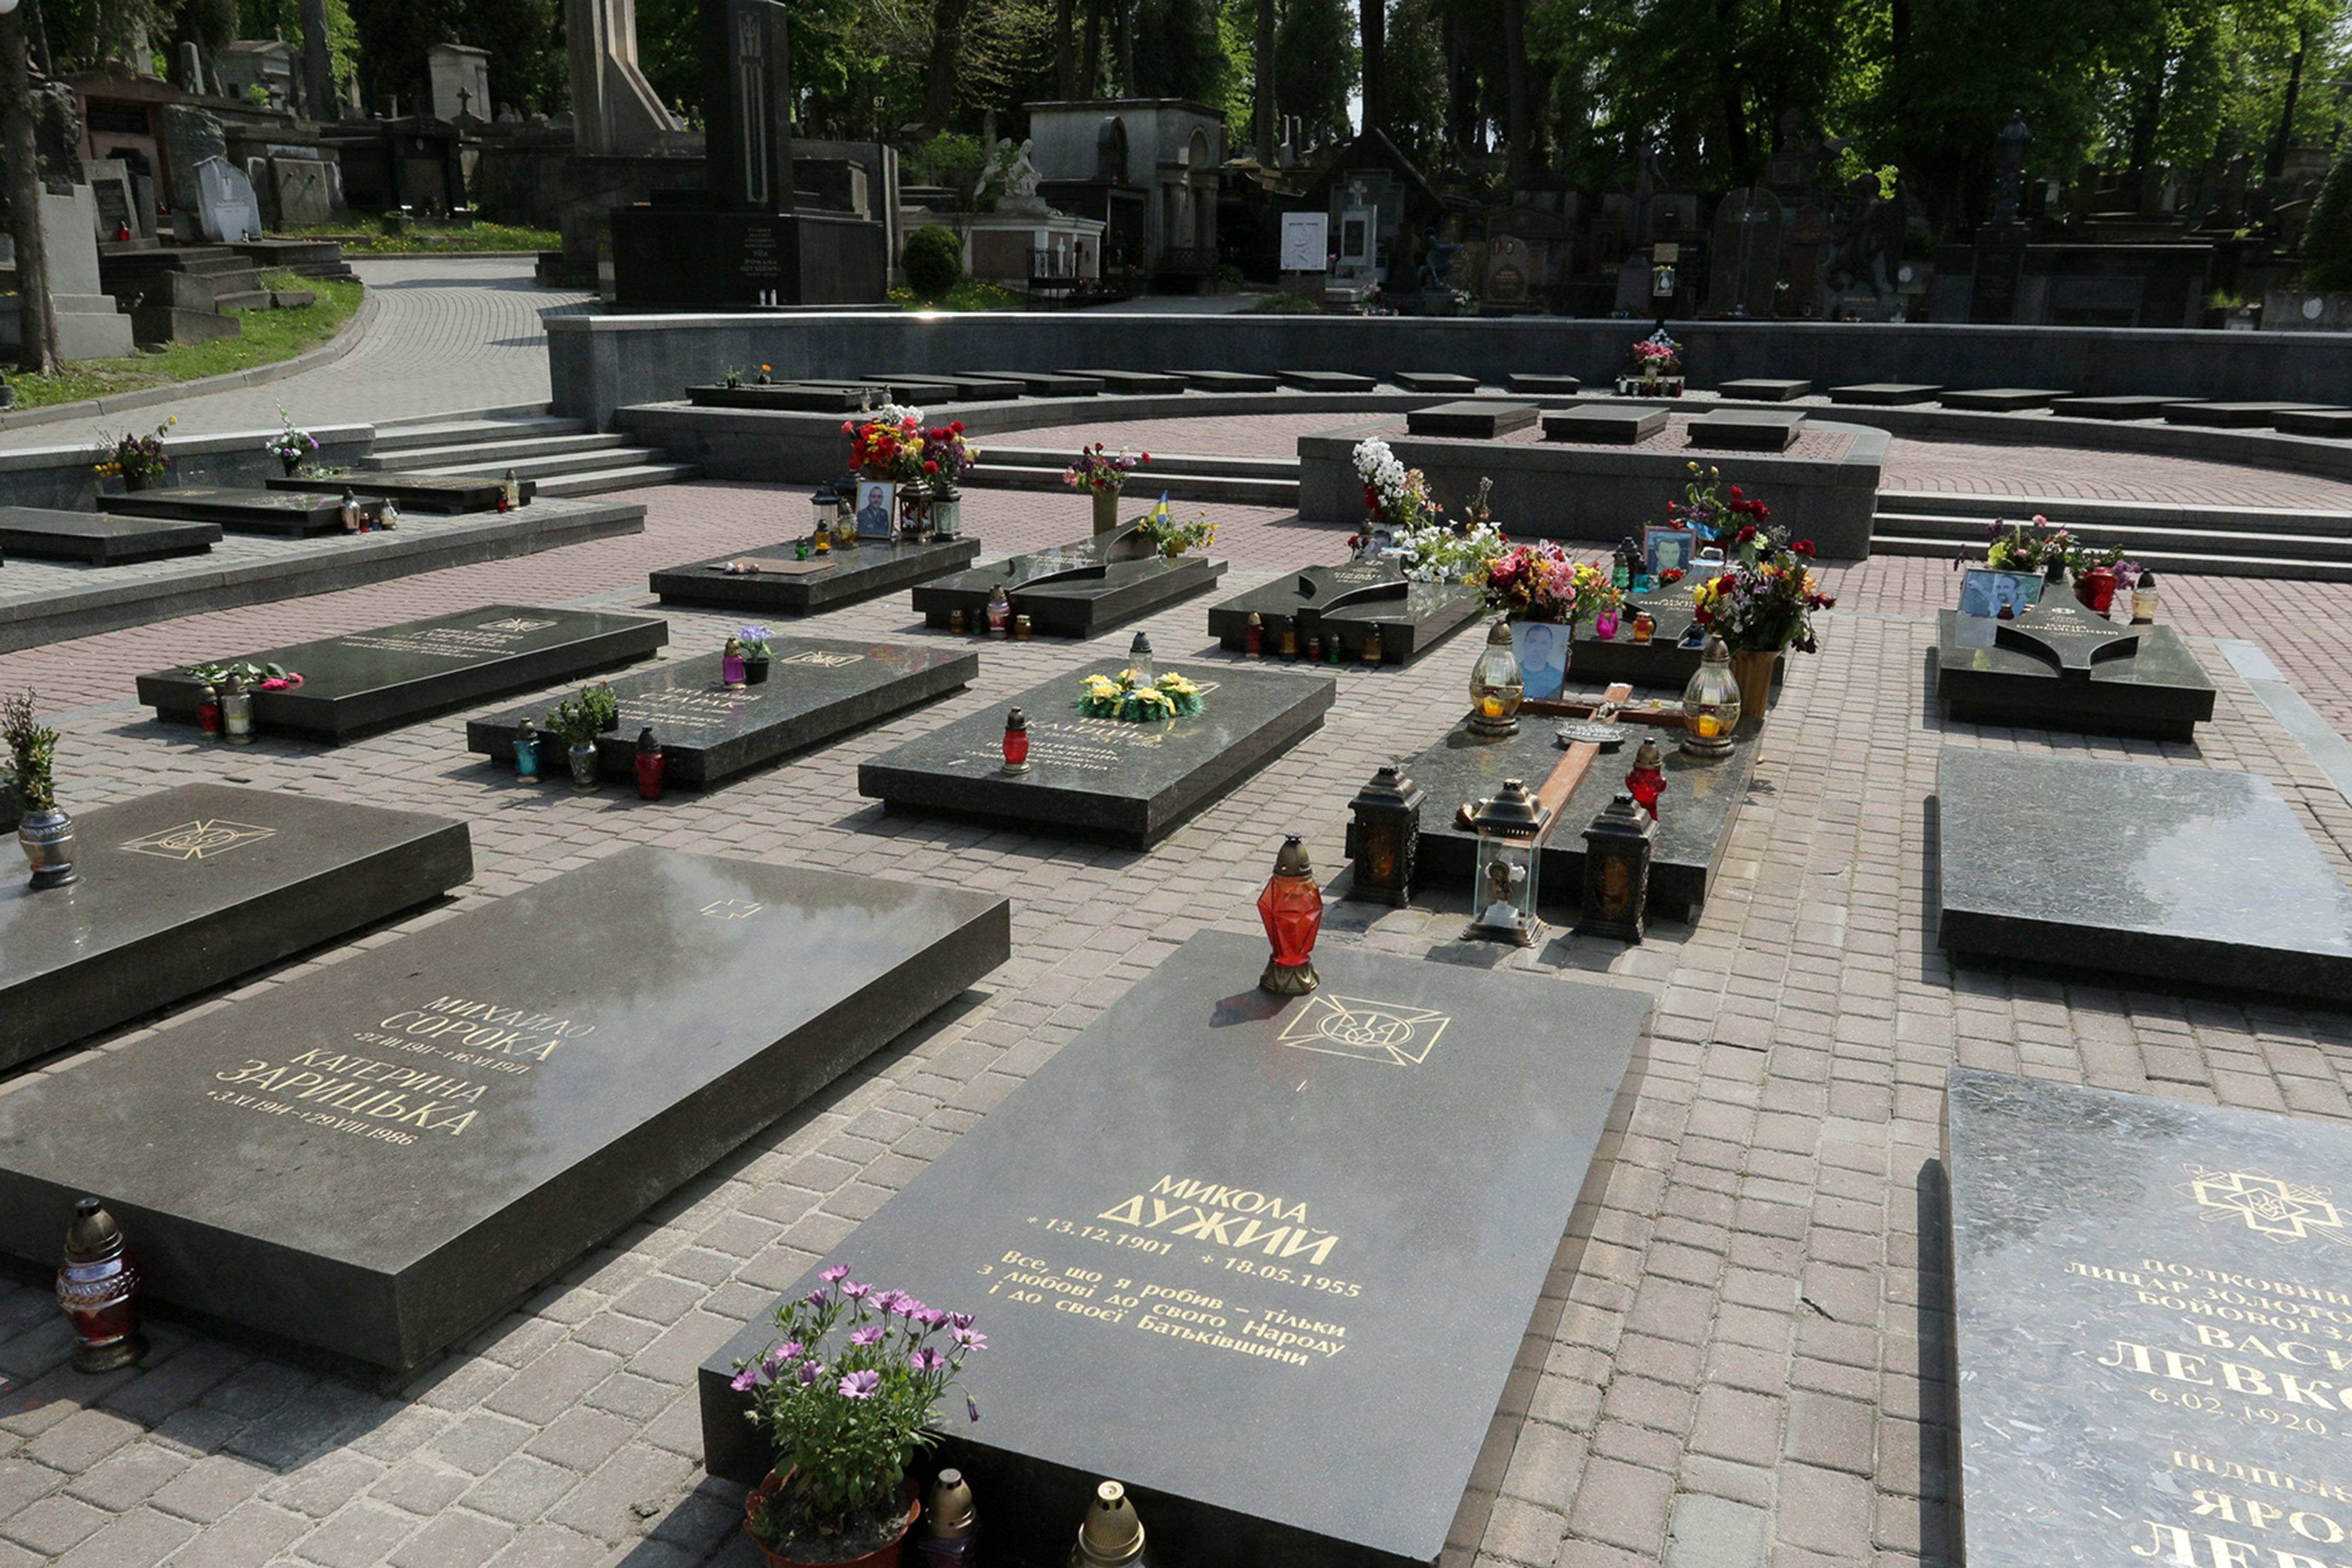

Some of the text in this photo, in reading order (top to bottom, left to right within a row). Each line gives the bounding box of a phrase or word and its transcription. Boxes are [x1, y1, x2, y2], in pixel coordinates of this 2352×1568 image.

[873, 96, 885, 107] 67
[380, 1011, 560, 1061] СОРОКА
[422, 996, 596, 1038] МИХАЙЛО
[215, 1059, 479, 1136] ЗАРИЦЬКА
[289, 1048, 488, 1103] КАТЕРИНА
[1149, 1175, 1306, 1224] МИКОЛА
[1097, 1194, 1339, 1265] ДУЖИЙ
[1045, 1218, 1172, 1255] 13.12.1901
[1225, 1258, 1362, 1297] 18.05.1955
[2064, 1261, 2190, 1294] ЛИЦАР
[976, 1264, 1346, 1358] з любові до свого Народу
[1001, 1250, 1049, 1274] Все,
[1113, 1278, 1132, 1289] я
[1140, 1284, 1224, 1310] робив
[1264, 1309, 1347, 1338] тільки
[2136, 1290, 2311, 1334] БОЙОВОЇ
[988, 1280, 1309, 1366] і до своєї Батьківщини
[2189, 1489, 2352, 1544] ЯРО
